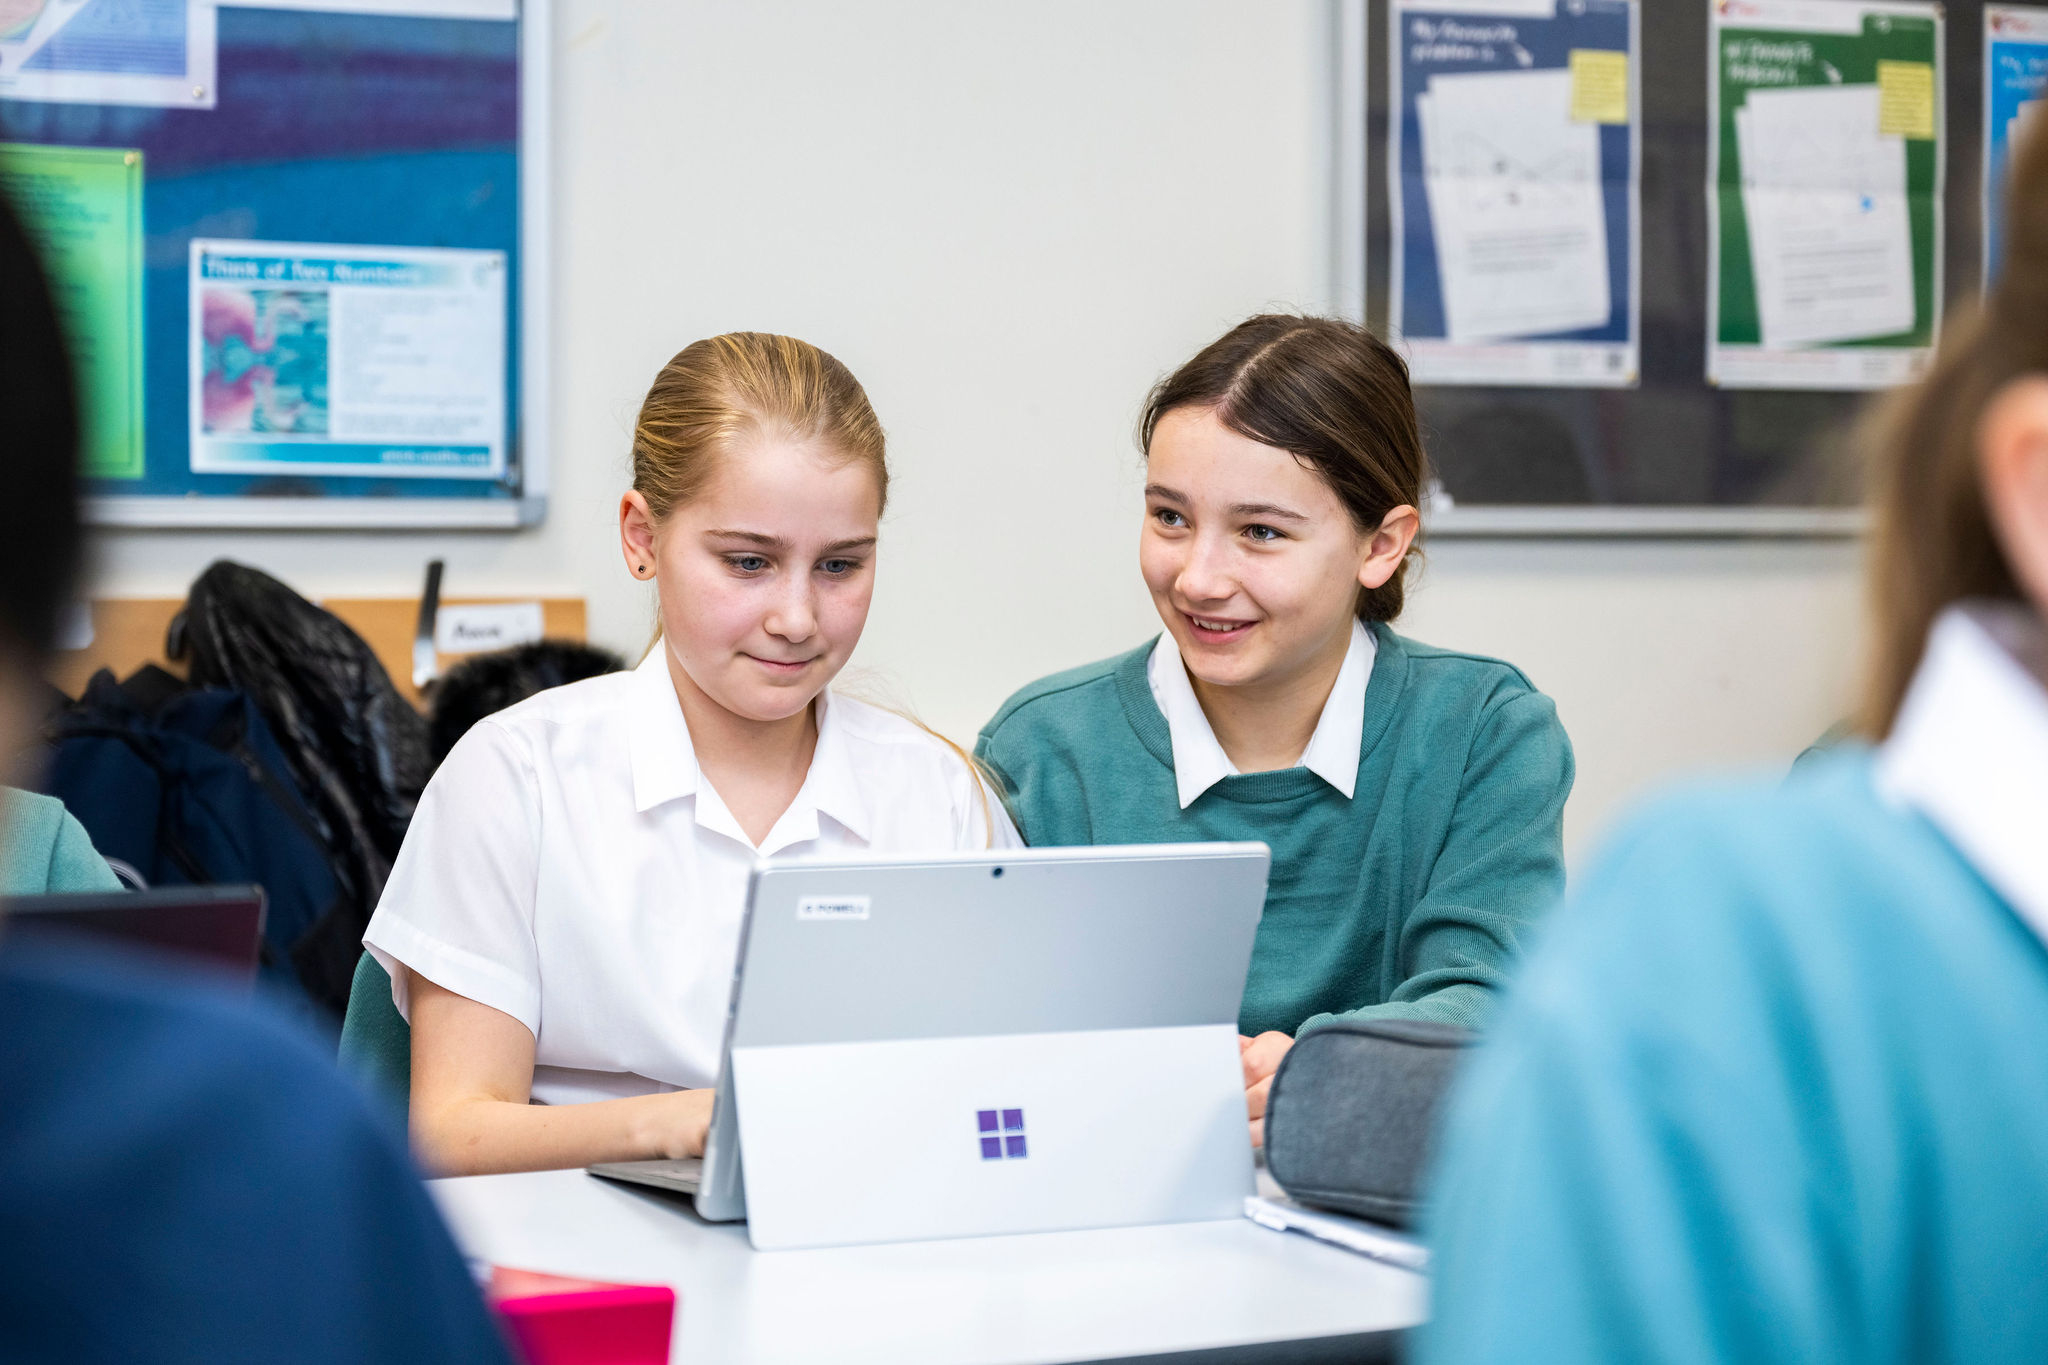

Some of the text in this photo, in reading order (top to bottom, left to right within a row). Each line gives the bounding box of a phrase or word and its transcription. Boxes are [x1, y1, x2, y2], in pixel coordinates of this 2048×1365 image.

[207, 257, 260, 279] Think
[263, 260, 286, 280] of
[291, 260, 330, 282] Two
